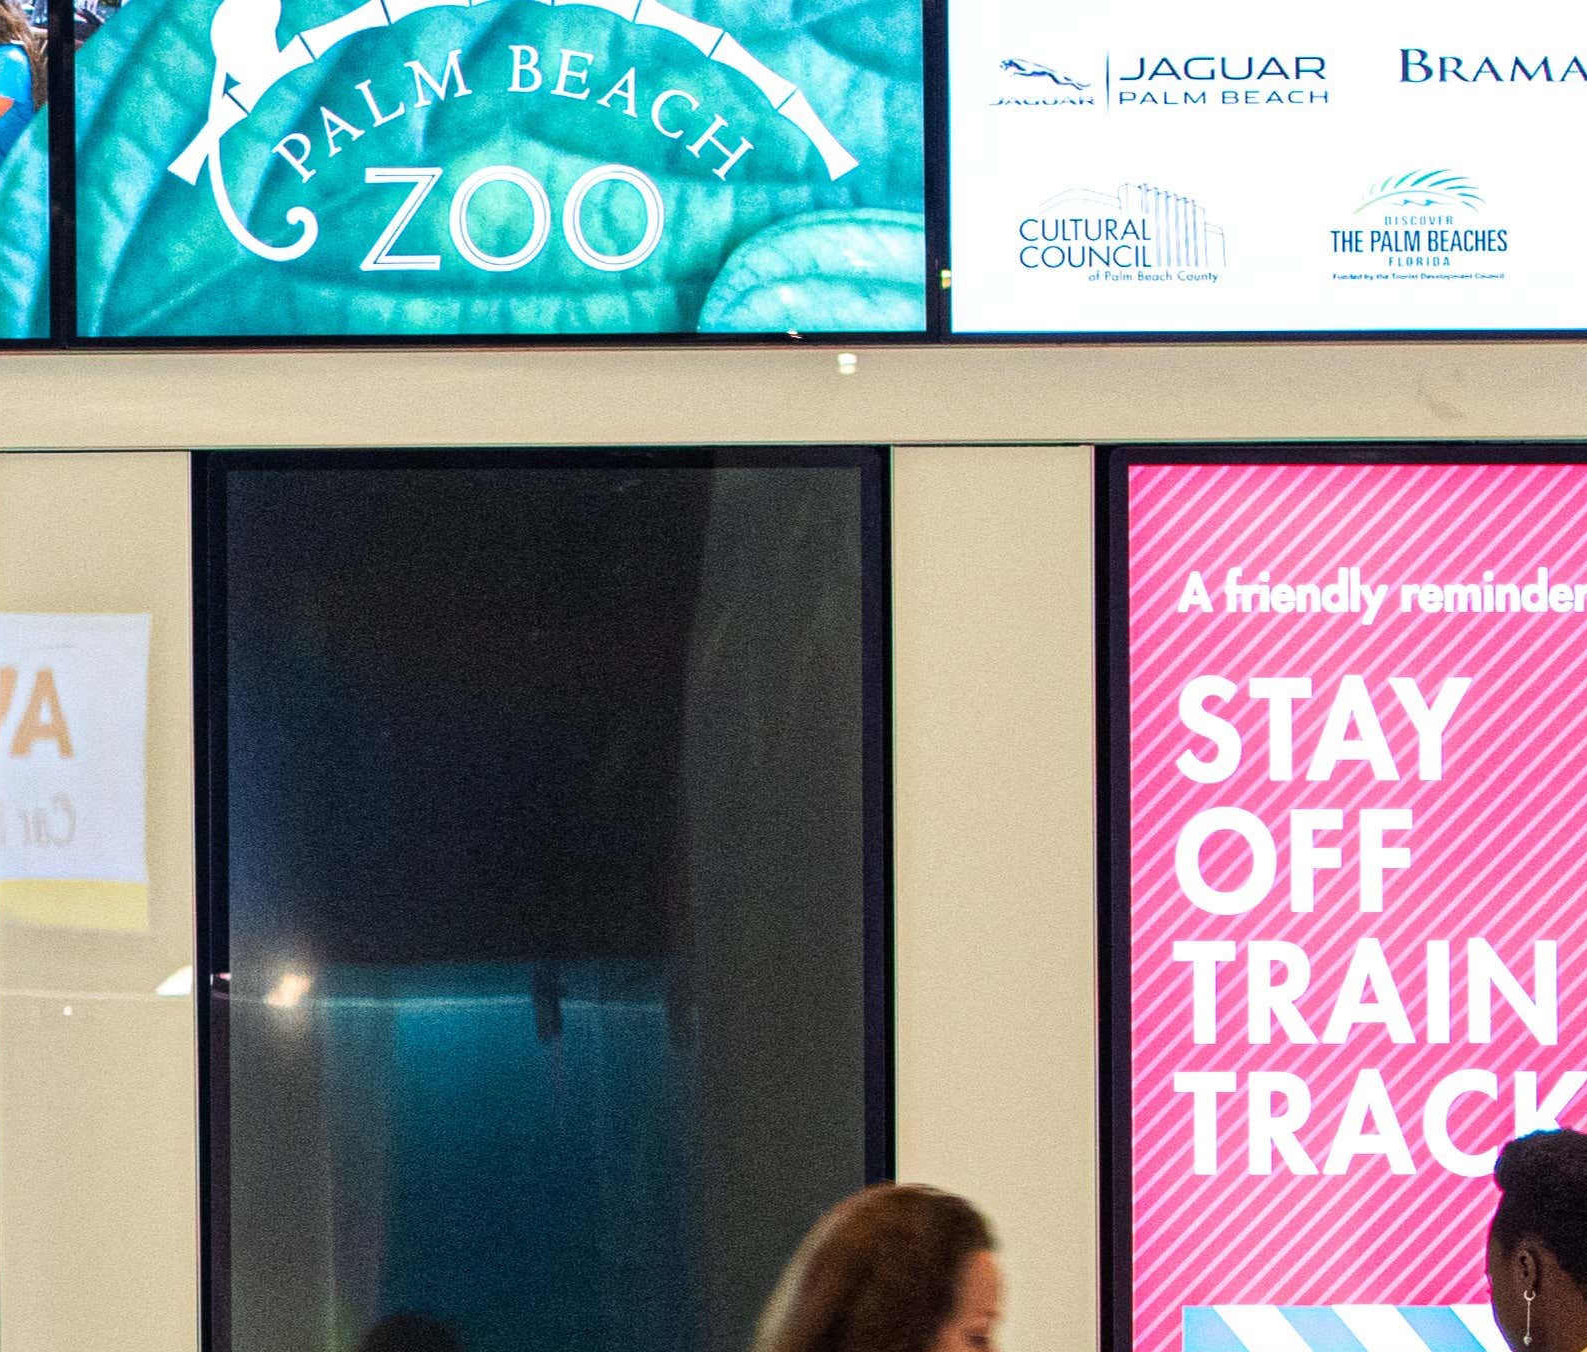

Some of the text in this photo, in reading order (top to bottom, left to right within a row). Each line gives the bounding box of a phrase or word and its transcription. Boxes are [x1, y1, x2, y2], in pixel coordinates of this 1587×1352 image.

[1120, 57, 1325, 80] JAGUAR
[1119, 91, 1327, 104] PALM BEACH
[271, 44, 756, 184] PALM BEACH
[360, 164, 665, 271] ZOO
[1019, 219, 1151, 241] CULTURAL
[1330, 230, 1507, 252] THE PALM BEACHES
[1020, 245, 1151, 268] COUNCIL
[1389, 256, 1450, 267] FLORIDA
[1105, 271, 1219, 283] Palm Beach County
[1177, 571, 1213, 612] A
[1224, 567, 1387, 624] friendly
[1175, 674, 1473, 784] STAY
[1175, 806, 1414, 915] OFF
[1173, 938, 1557, 1045] TRAIN
